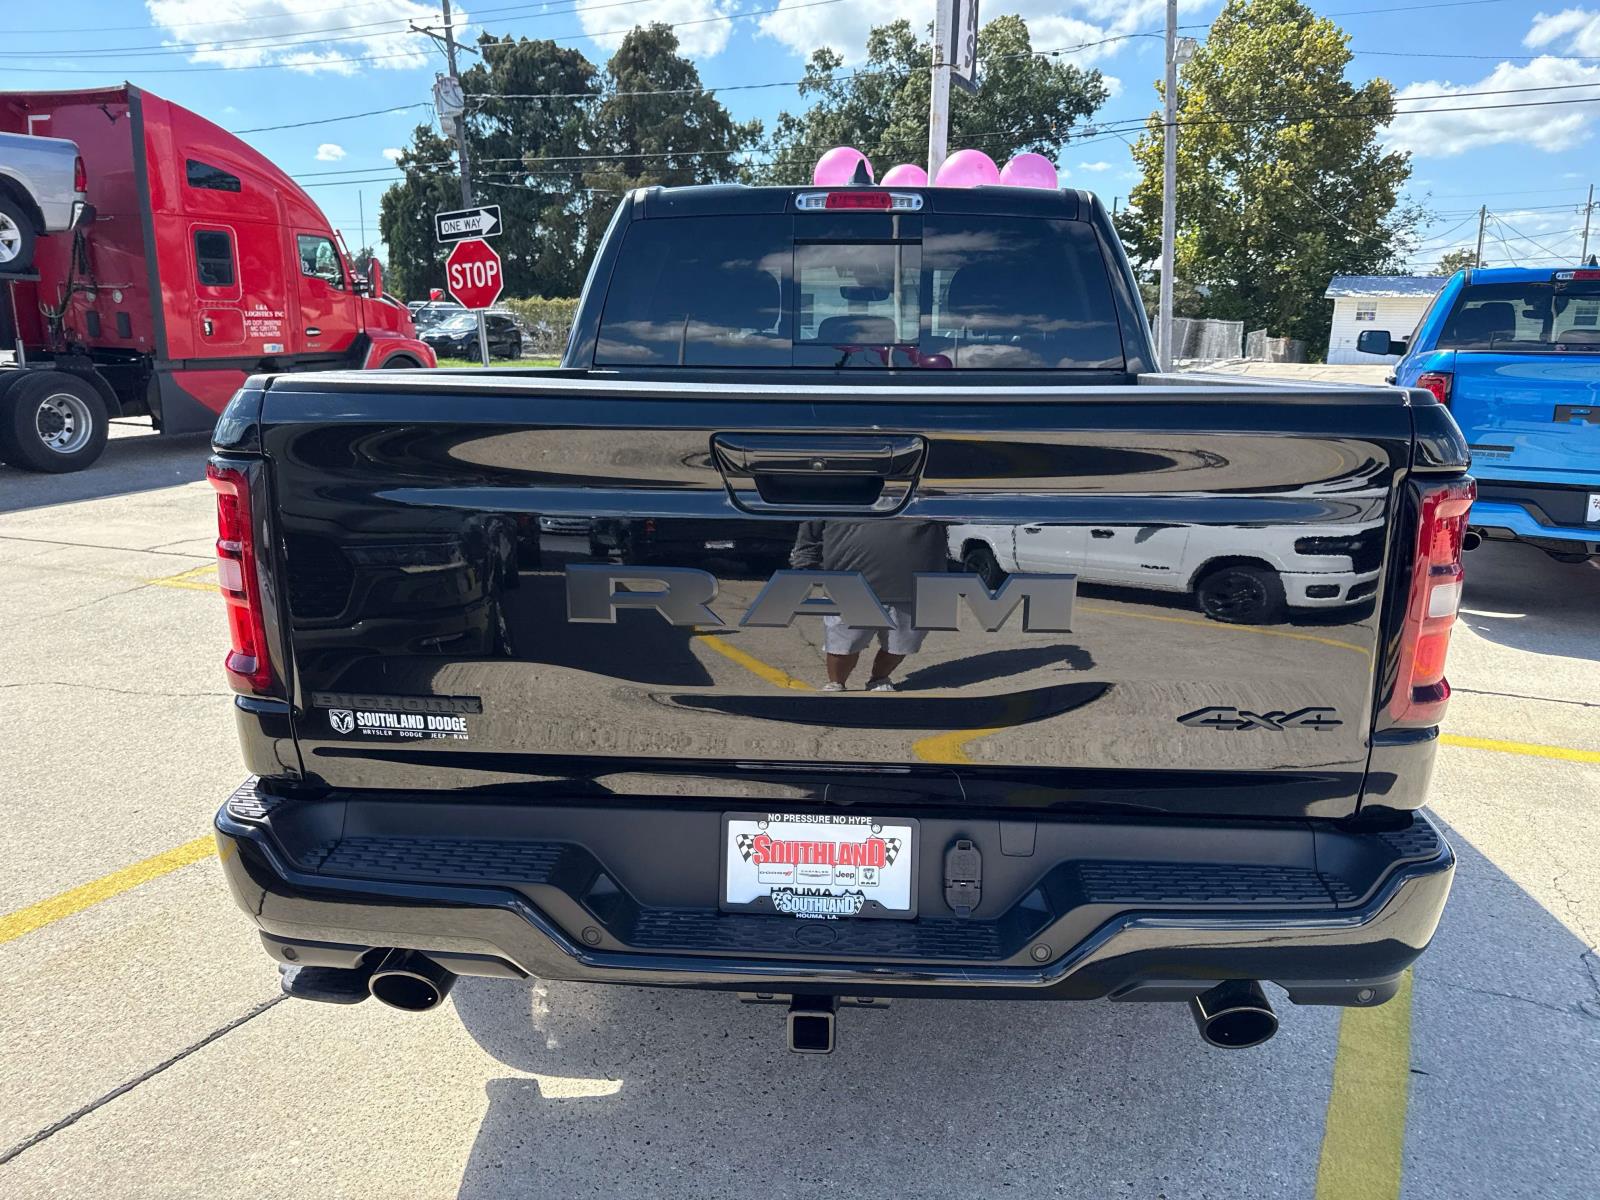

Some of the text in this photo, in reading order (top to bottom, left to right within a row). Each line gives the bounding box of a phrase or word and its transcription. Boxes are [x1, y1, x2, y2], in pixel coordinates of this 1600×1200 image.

[443, 217, 482, 233] ONE WAY
[451, 260, 498, 290] STOP
[565, 563, 1078, 633] RAM
[357, 711, 468, 732] SOUTHLAND DODGE
[768, 813, 873, 825] NO PRESSURE NO HYPE
[752, 834, 887, 869] SOUTHLAND
[835, 870, 855, 879] Jeep
[782, 893, 855, 914] SOUTHLAND
